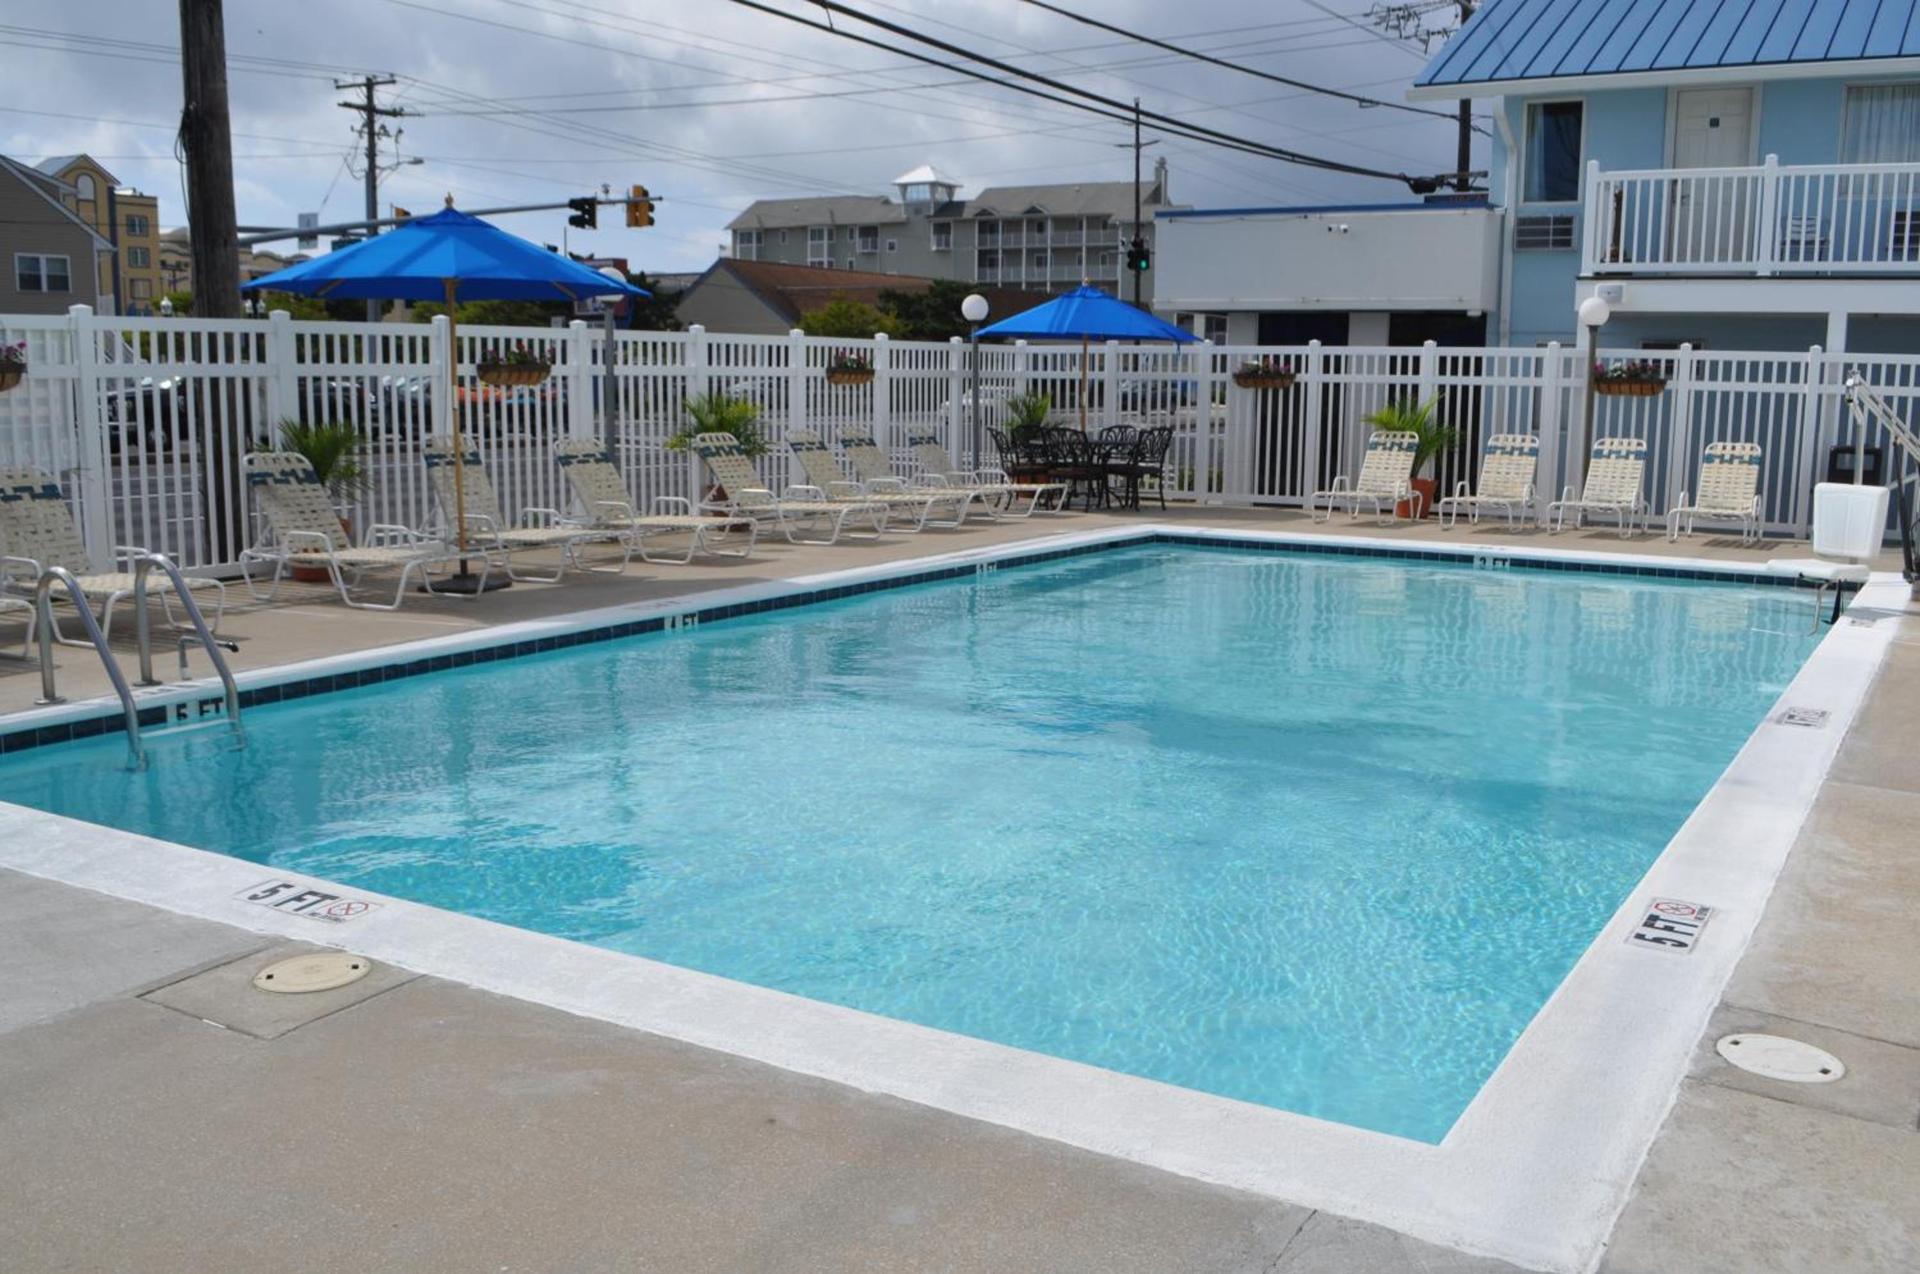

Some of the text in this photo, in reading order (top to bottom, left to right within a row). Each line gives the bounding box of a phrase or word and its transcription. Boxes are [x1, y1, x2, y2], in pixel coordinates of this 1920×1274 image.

[682, 612, 697, 627] FT
[176, 696, 224, 720] 5 FT
[247, 883, 340, 912] 5 FT
[1634, 913, 1698, 948] 5 FT
